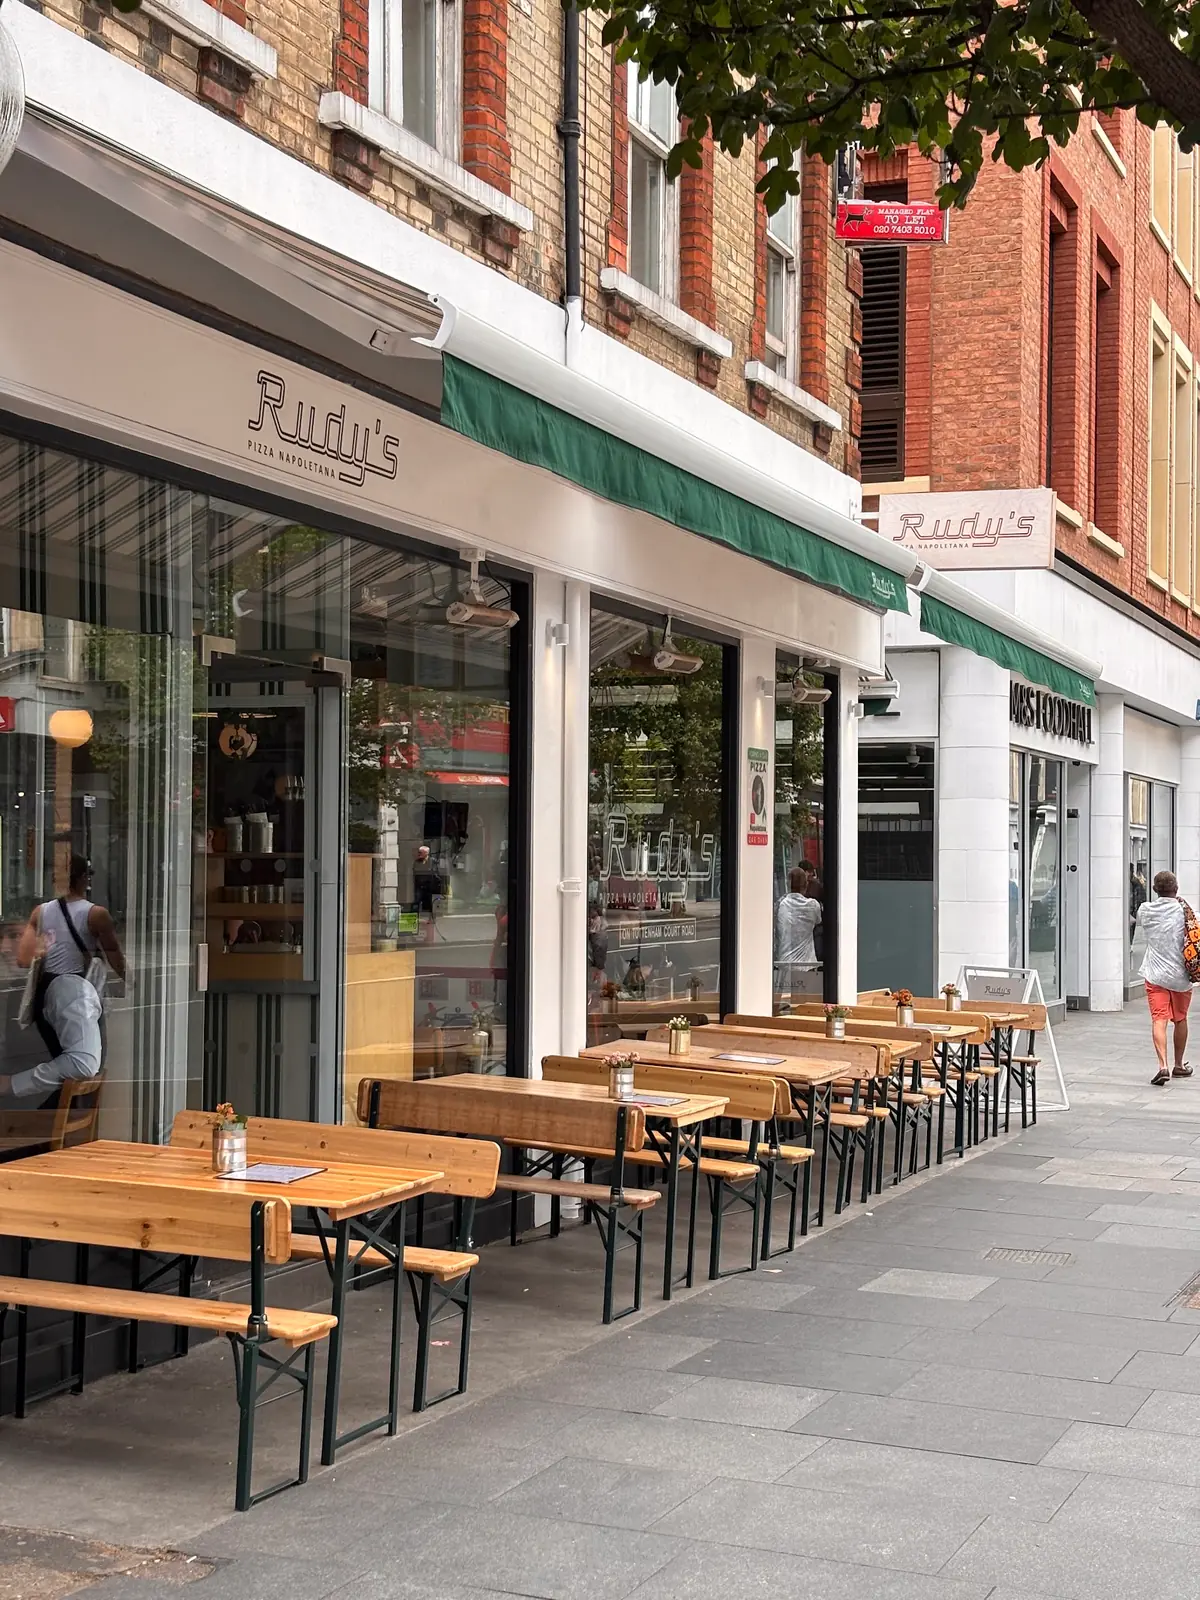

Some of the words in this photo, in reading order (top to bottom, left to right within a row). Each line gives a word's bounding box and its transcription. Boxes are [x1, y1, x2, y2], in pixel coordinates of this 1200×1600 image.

[916, 208, 935, 216] FLAT
[884, 215, 900, 224] TO
[904, 215, 926, 225] LET
[873, 225, 890, 234] 020
[891, 225, 913, 234] 7403
[914, 226, 936, 235] 5010
[248, 369, 399, 487] Rudy's
[247, 440, 274, 458] PIZZA
[279, 450, 336, 479] NAPOLETANA
[893, 511, 1036, 548] Rudy's
[1009, 680, 1035, 727] M&S
[1035, 690, 1095, 745] FOODHALL
[750, 761, 767, 773] PIZZA
[599, 812, 714, 902] Rudy's
[599, 892, 620, 904] PIZZA
[622, 928, 630, 940] ON
[663, 925, 680, 938] COURT
[681, 925, 695, 936] ROAD
[984, 985, 1012, 997] Rudy's
